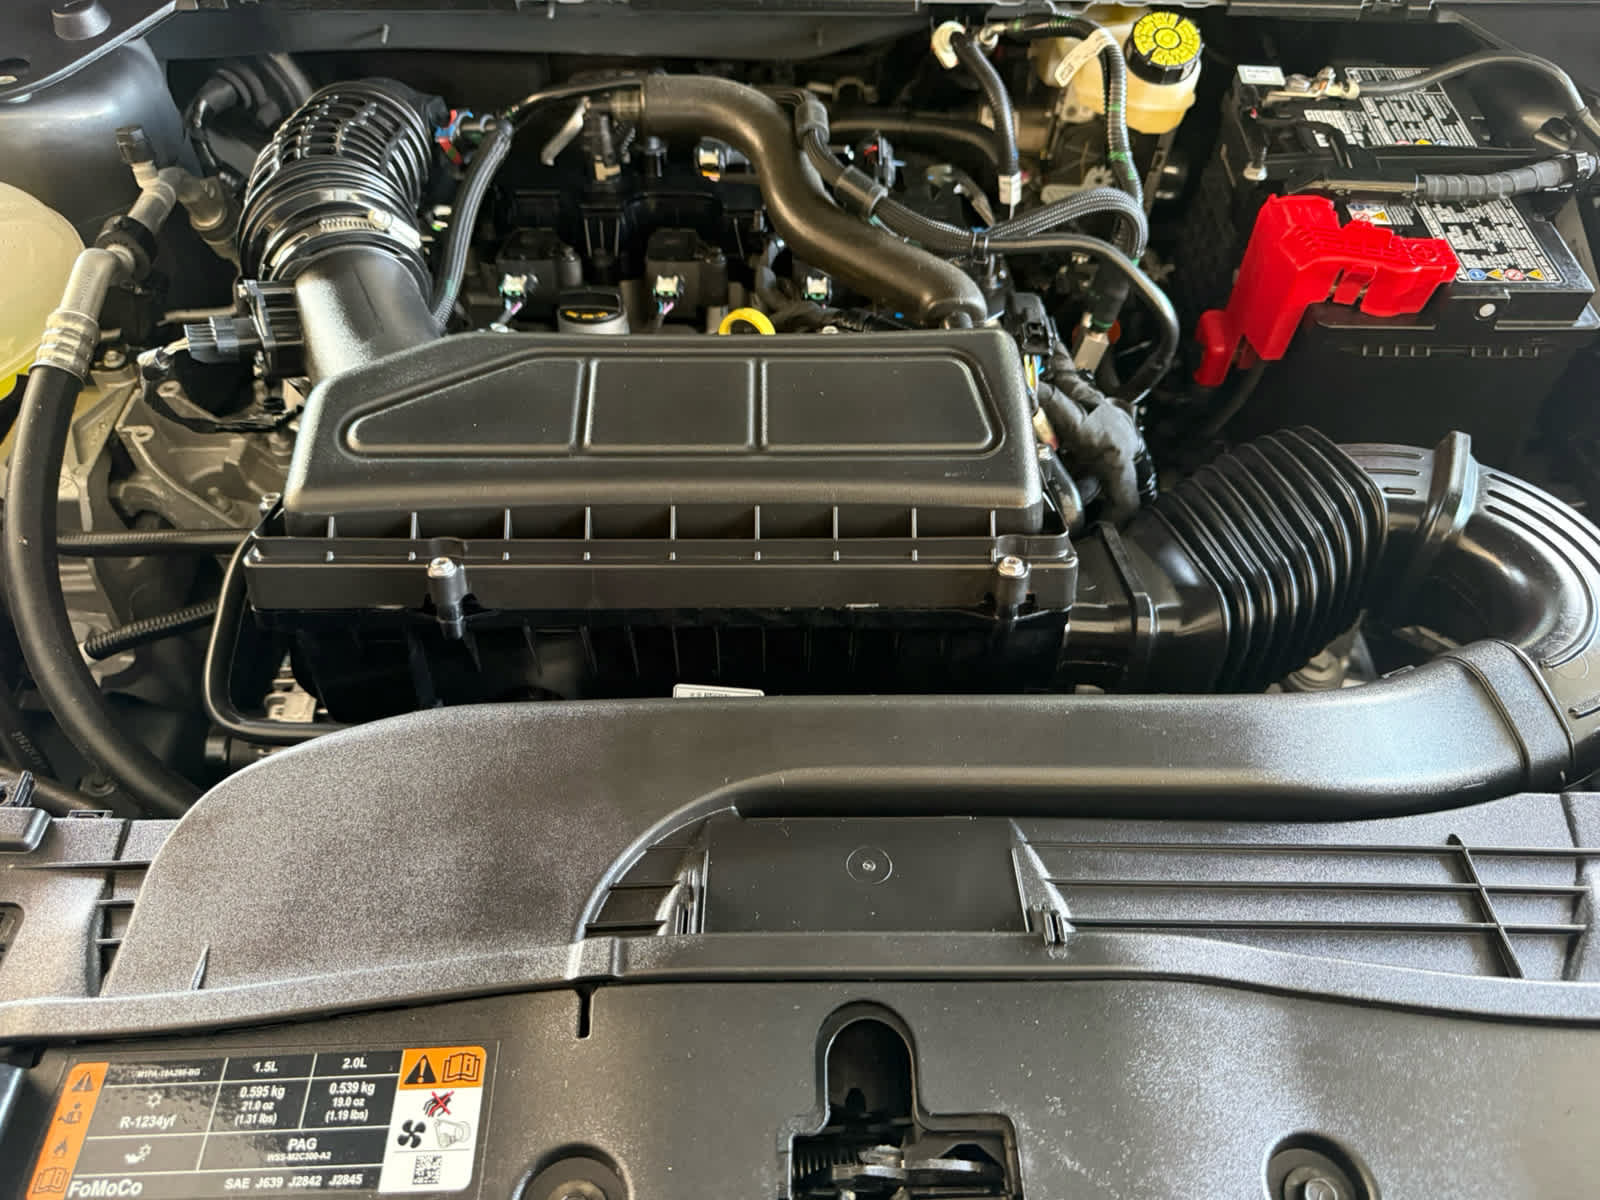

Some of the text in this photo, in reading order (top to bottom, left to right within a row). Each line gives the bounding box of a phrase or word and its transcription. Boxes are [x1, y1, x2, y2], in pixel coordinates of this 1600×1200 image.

[254, 1061, 279, 1073] 1.5L
[342, 1057, 368, 1069] 2.0L
[239, 1085, 286, 1100] 0.595 kg
[329, 1081, 376, 1096] 0.539 kg
[262, 1101, 275, 1111] oz
[332, 1097, 366, 1108] 19.0 oz
[119, 1114, 177, 1129] R-1234yf
[234, 1113, 278, 1127] (1.31 lbs)
[324, 1109, 369, 1123] (1.19 lbs)
[287, 1137, 318, 1151] PAG
[67, 1179, 143, 1198] FoMoCo
[224, 1173, 363, 1190] SAE J639 J2842 J2845
